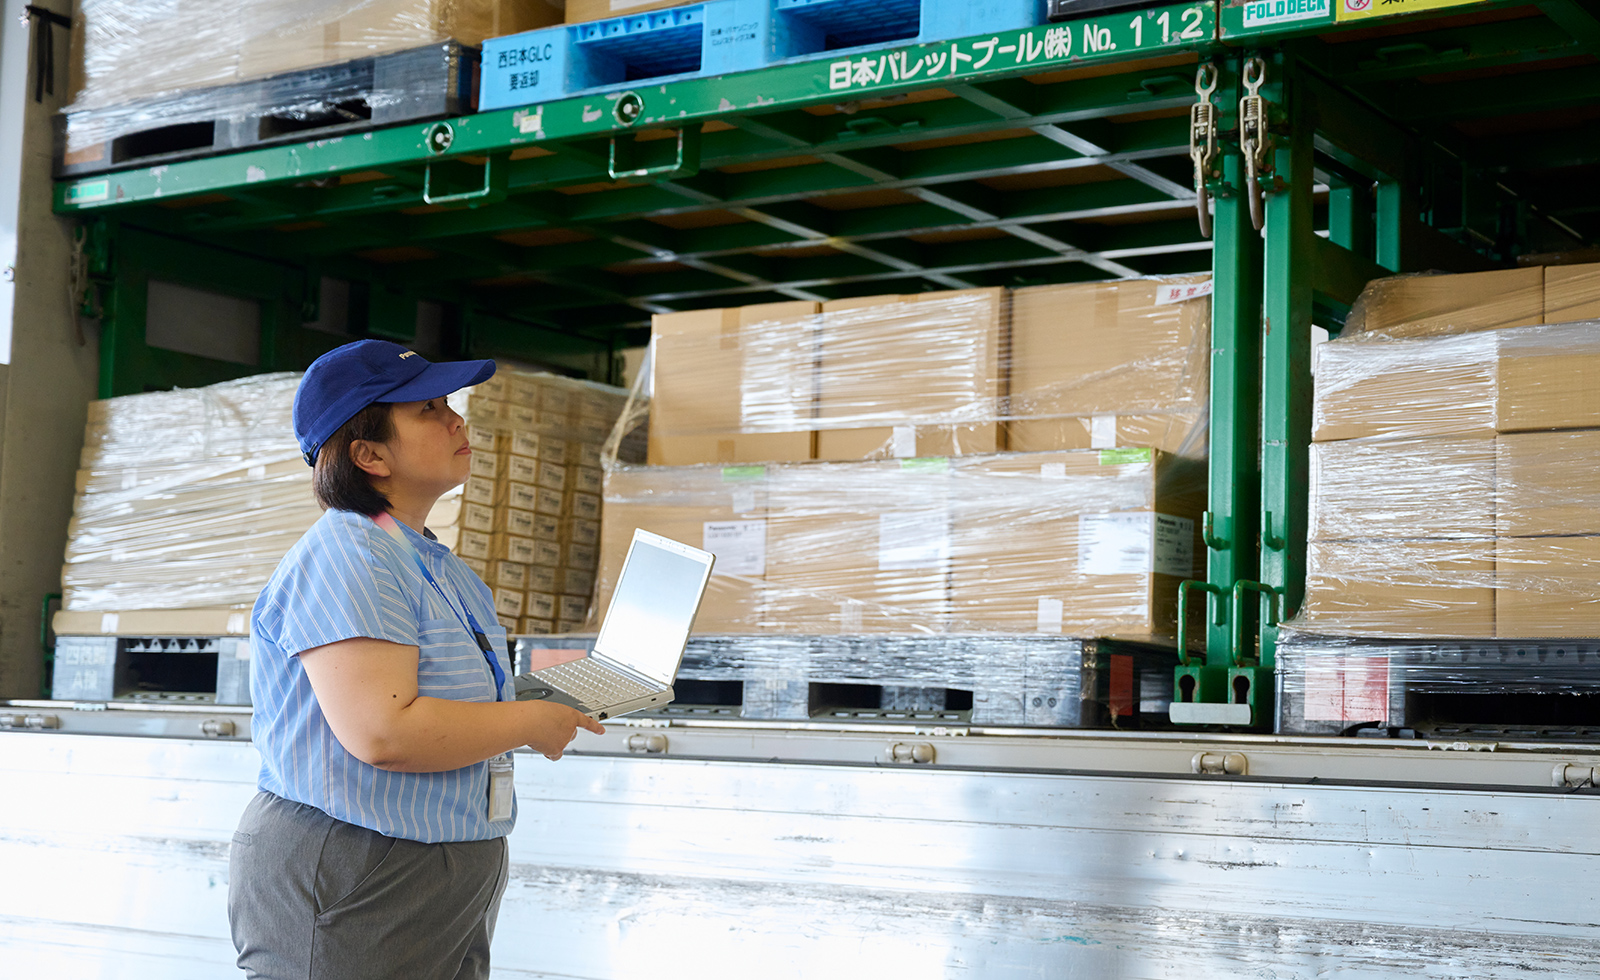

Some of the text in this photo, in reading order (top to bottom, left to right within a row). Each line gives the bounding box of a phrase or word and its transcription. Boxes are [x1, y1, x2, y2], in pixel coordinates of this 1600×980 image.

[1083, 23, 1117, 54] No.
[498, 43, 552, 68] 西日本GLC
[509, 70, 539, 91] 要返却
